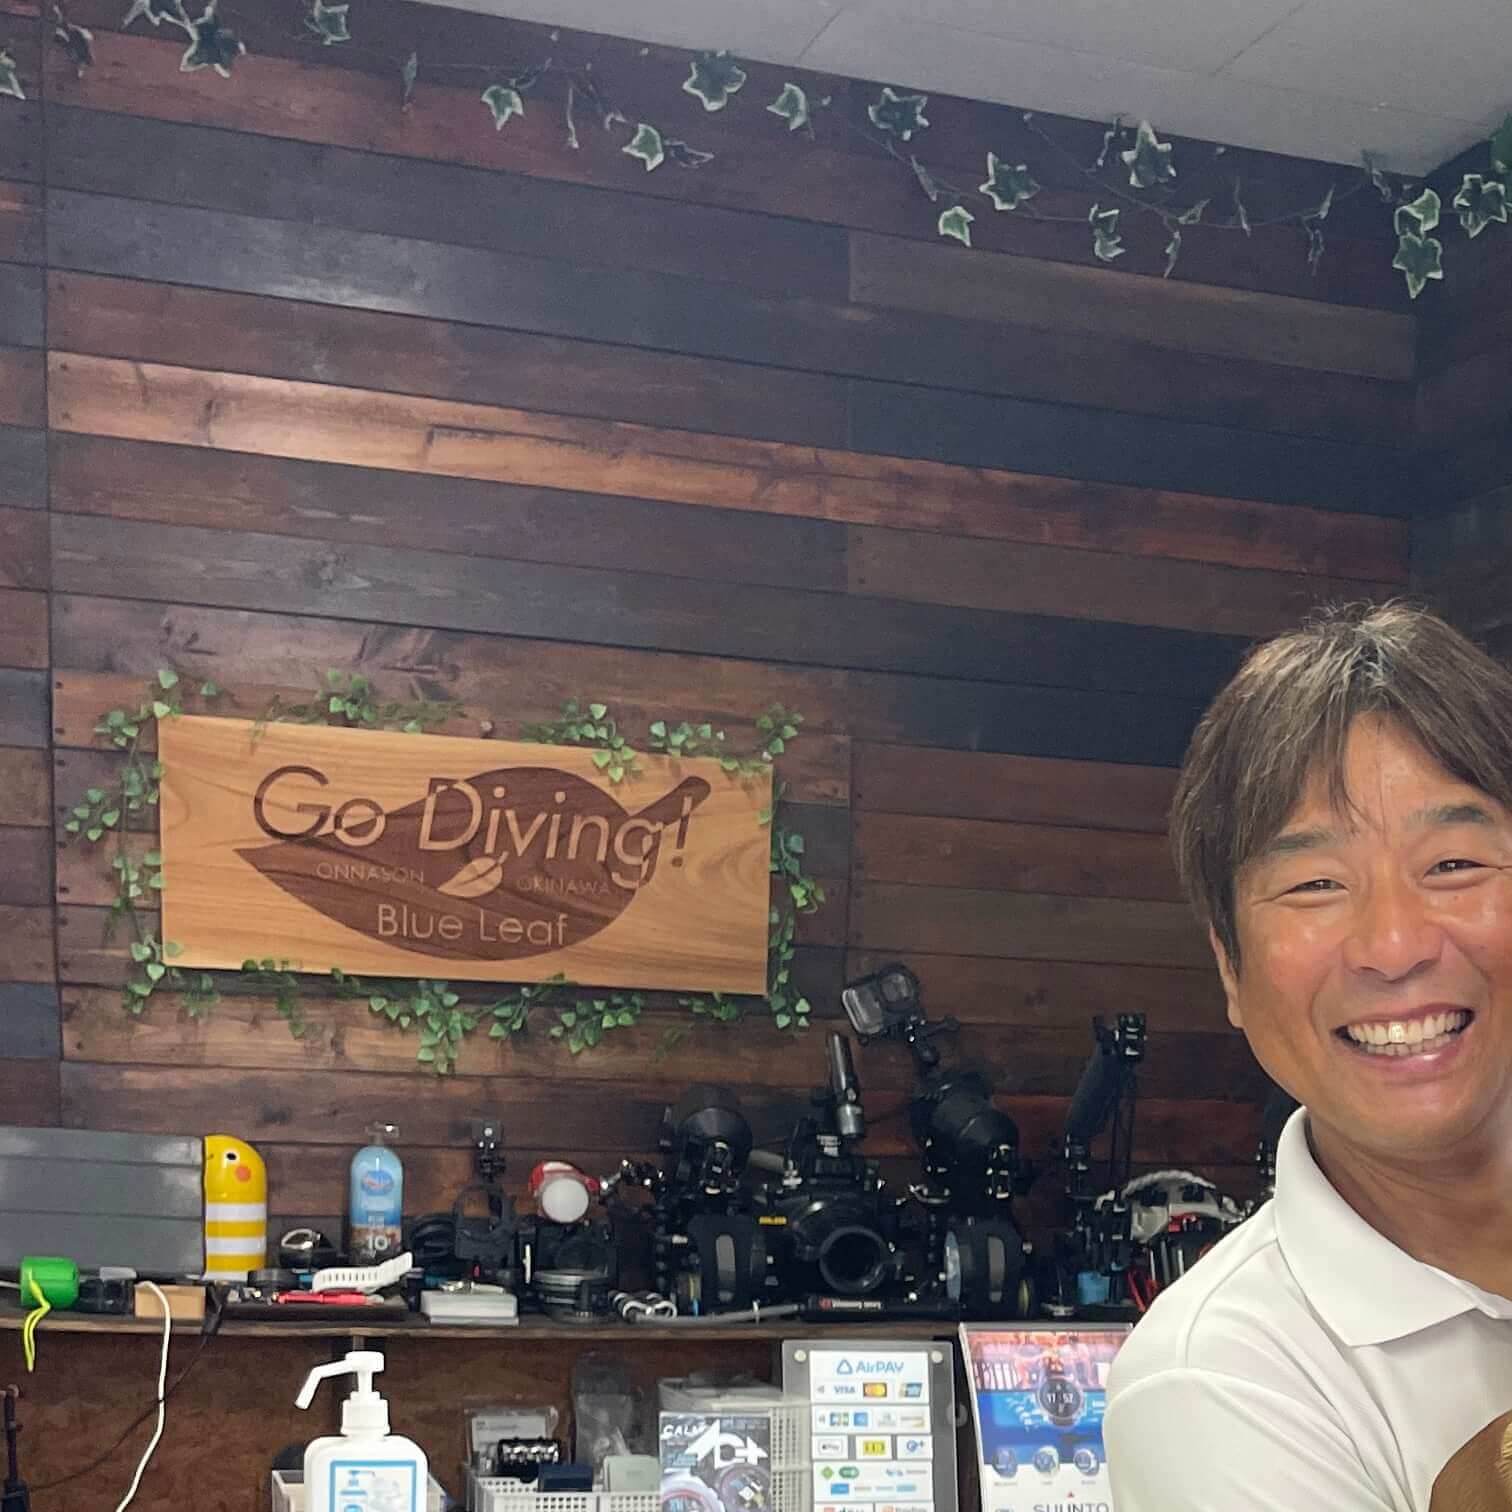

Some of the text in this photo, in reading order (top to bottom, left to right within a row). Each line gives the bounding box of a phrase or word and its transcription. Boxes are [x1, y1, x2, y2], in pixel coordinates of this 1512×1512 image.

[254, 765, 694, 890] Go Diving!
[316, 861, 610, 895] ONNASON OKINAWA
[377, 904, 568, 945] Blue Leaf
[856, 1360, 905, 1374] AirPAY
[834, 1385, 856, 1394] VISA
